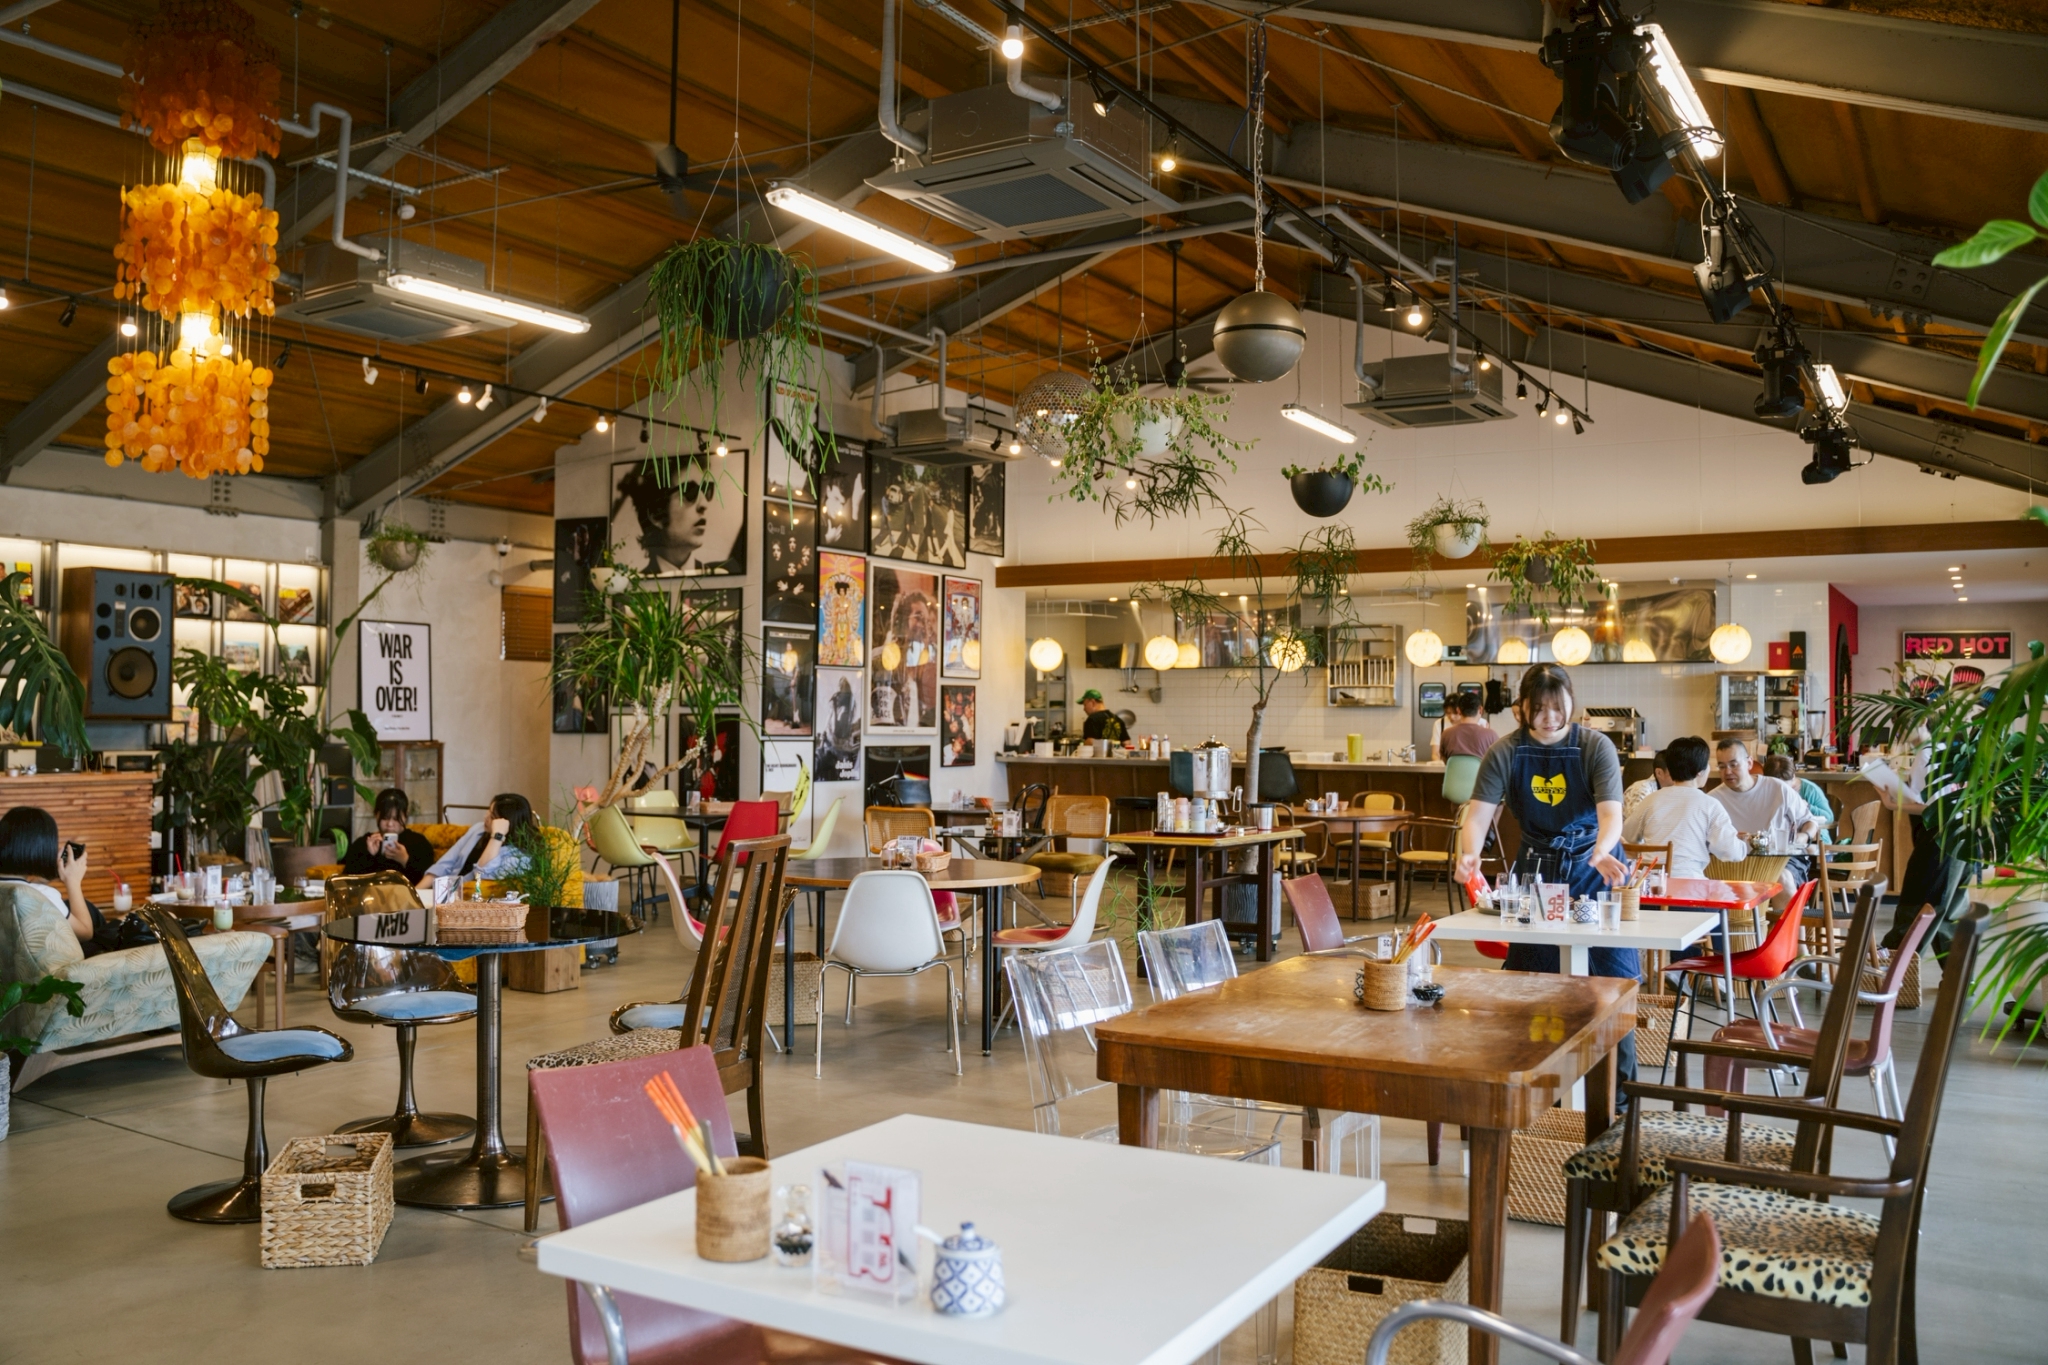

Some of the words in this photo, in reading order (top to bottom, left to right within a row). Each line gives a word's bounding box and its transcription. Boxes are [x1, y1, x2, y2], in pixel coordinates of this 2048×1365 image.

[379, 633, 412, 659] WAR
[1906, 637, 1954, 654] RED
[1960, 637, 2009, 654] HOT
[390, 660, 403, 685] IS
[376, 686, 417, 712] OVER!
